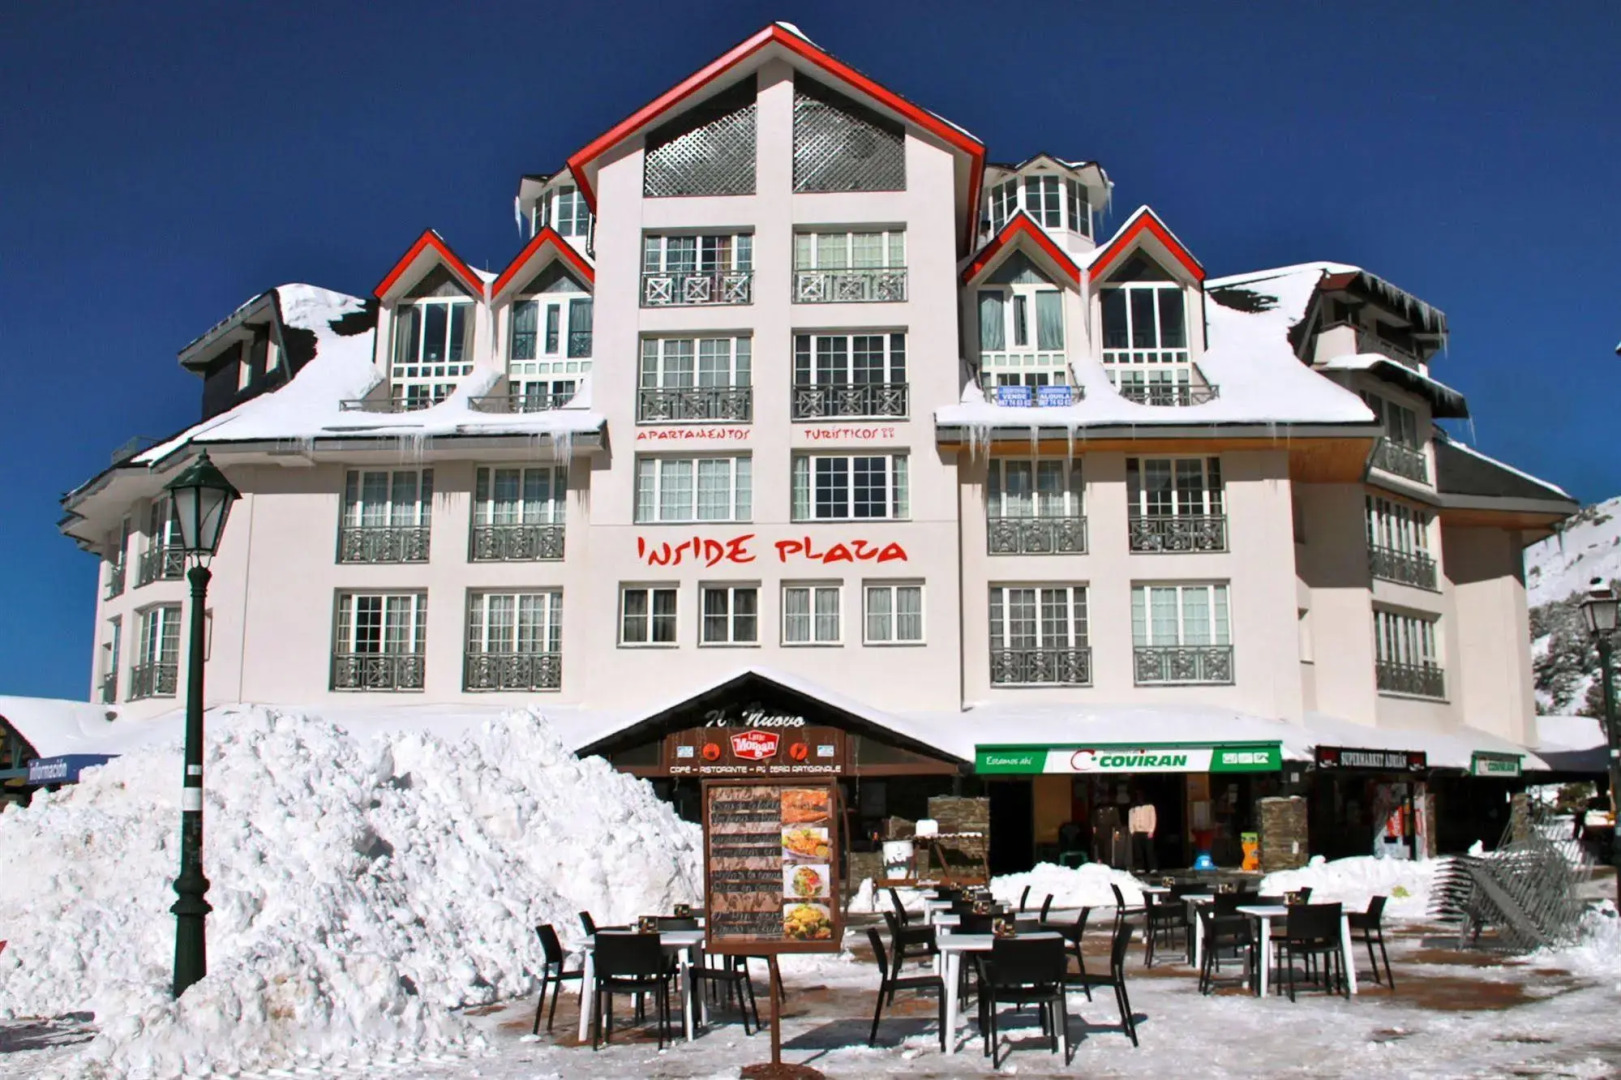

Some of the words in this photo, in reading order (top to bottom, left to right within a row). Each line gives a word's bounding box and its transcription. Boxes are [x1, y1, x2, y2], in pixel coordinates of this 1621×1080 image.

[636, 428, 751, 441] APARTAMENTOS
[637, 534, 757, 568] INSIDE
[774, 536, 908, 564] PLAZA
[742, 711, 807, 728] Nuovo
[733, 738, 775, 758] Morgan
[1099, 754, 1188, 768] COVIRAN
[1340, 751, 1384, 767] SUPERMARKET
[699, 765, 748, 774] RISTORANTE
